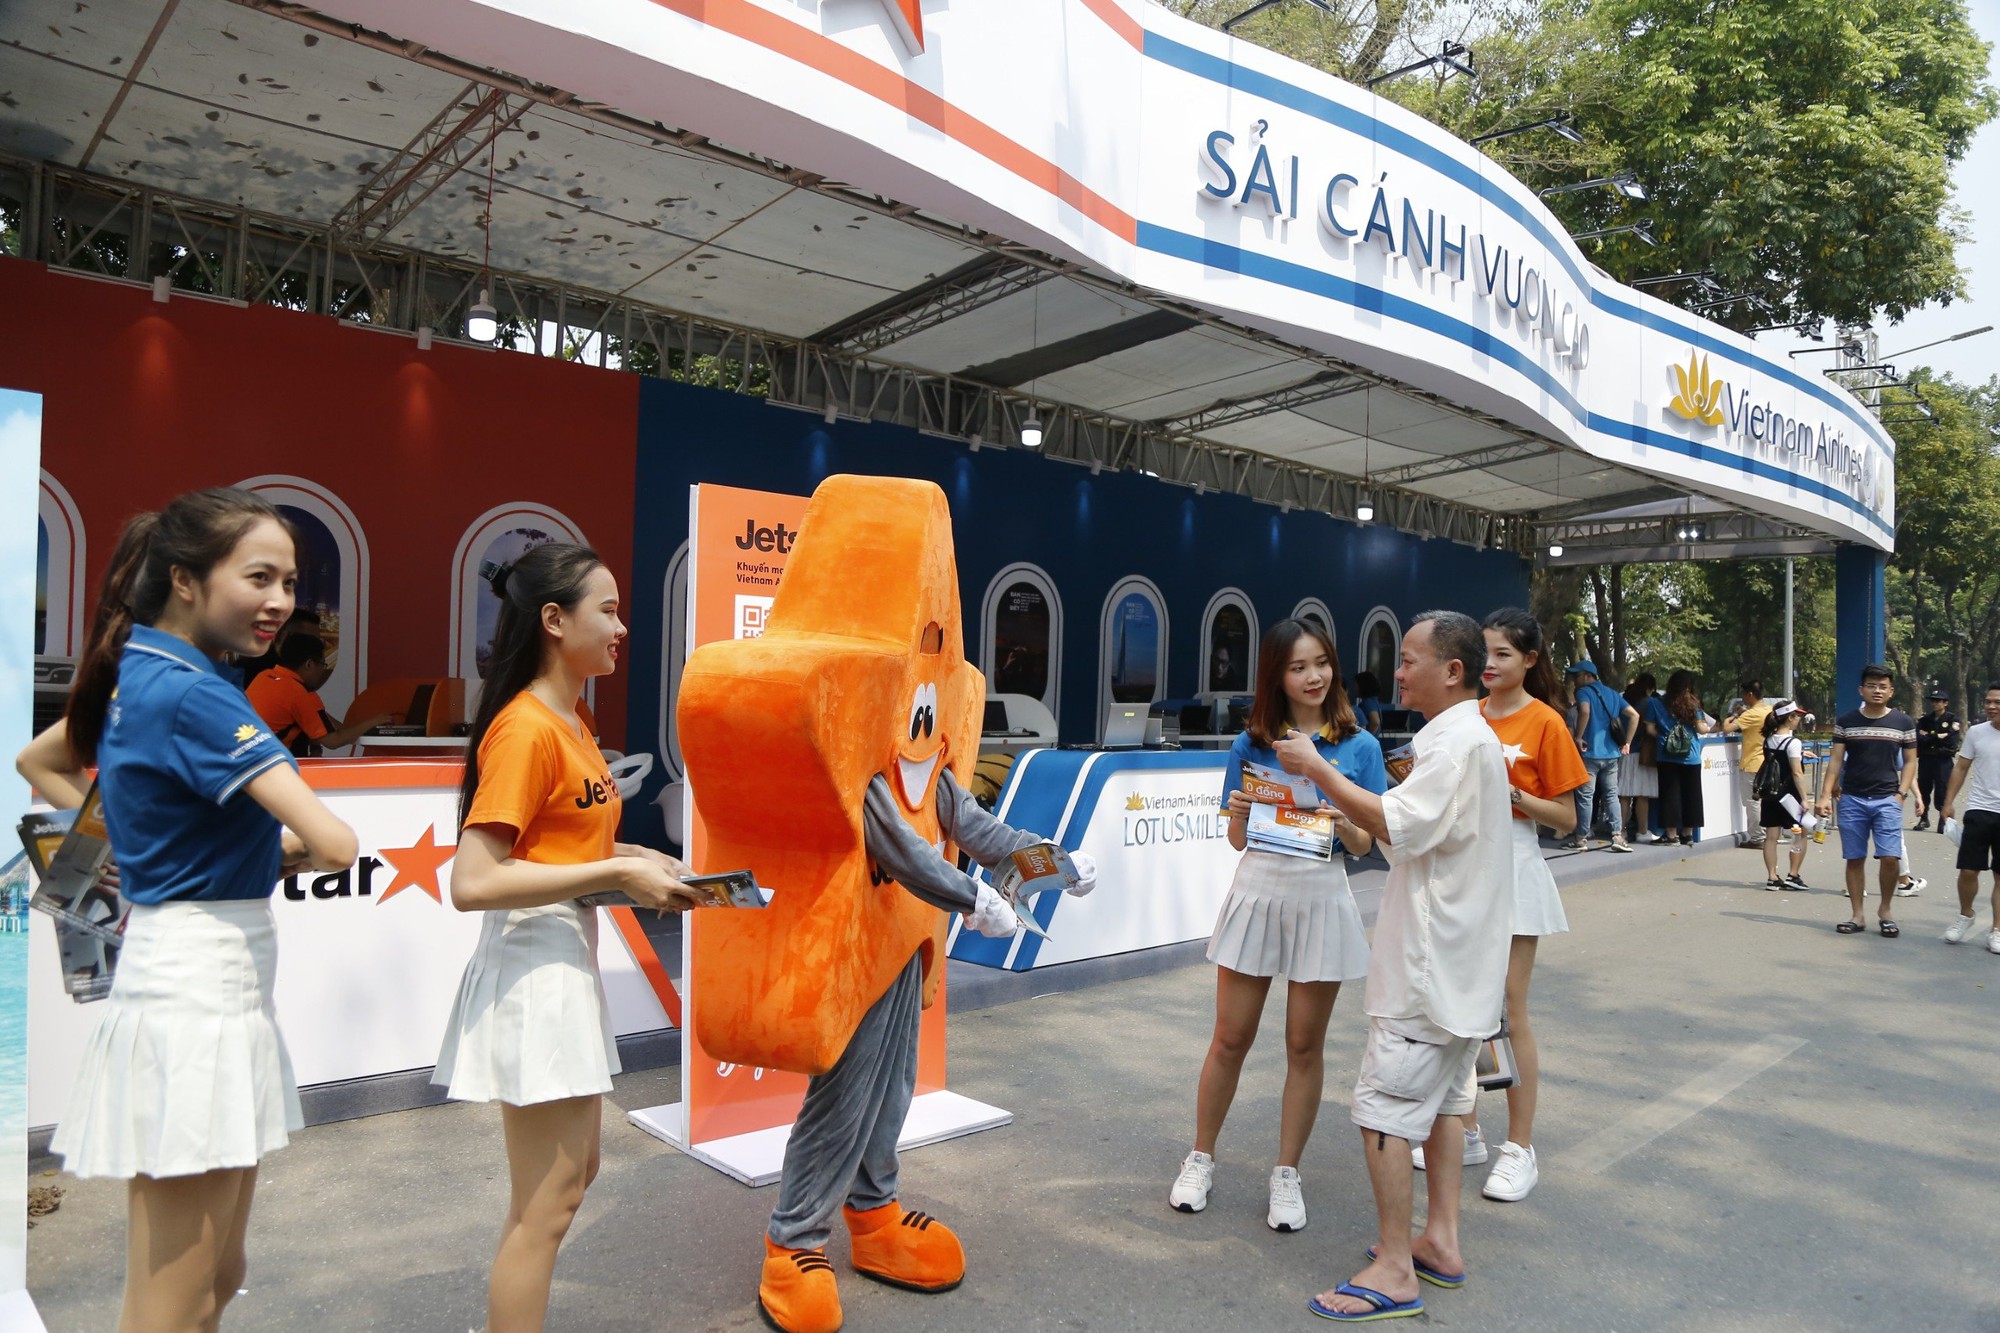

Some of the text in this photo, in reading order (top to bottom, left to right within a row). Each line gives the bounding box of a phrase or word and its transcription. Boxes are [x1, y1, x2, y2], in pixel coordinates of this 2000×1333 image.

[1204, 118, 1590, 370] SẢI CÁNH VƯƠN CAO
[1726, 382, 1863, 482] Vietnam Airlines
[736, 561, 770, 575] Khuyến
[736, 573, 773, 586] Vietnam
[1246, 782, 1253, 792] 0
[1255, 785, 1285, 801] đồng
[1144, 793, 1221, 810] Vietnam Airlines
[1318, 818, 1327, 827] 0
